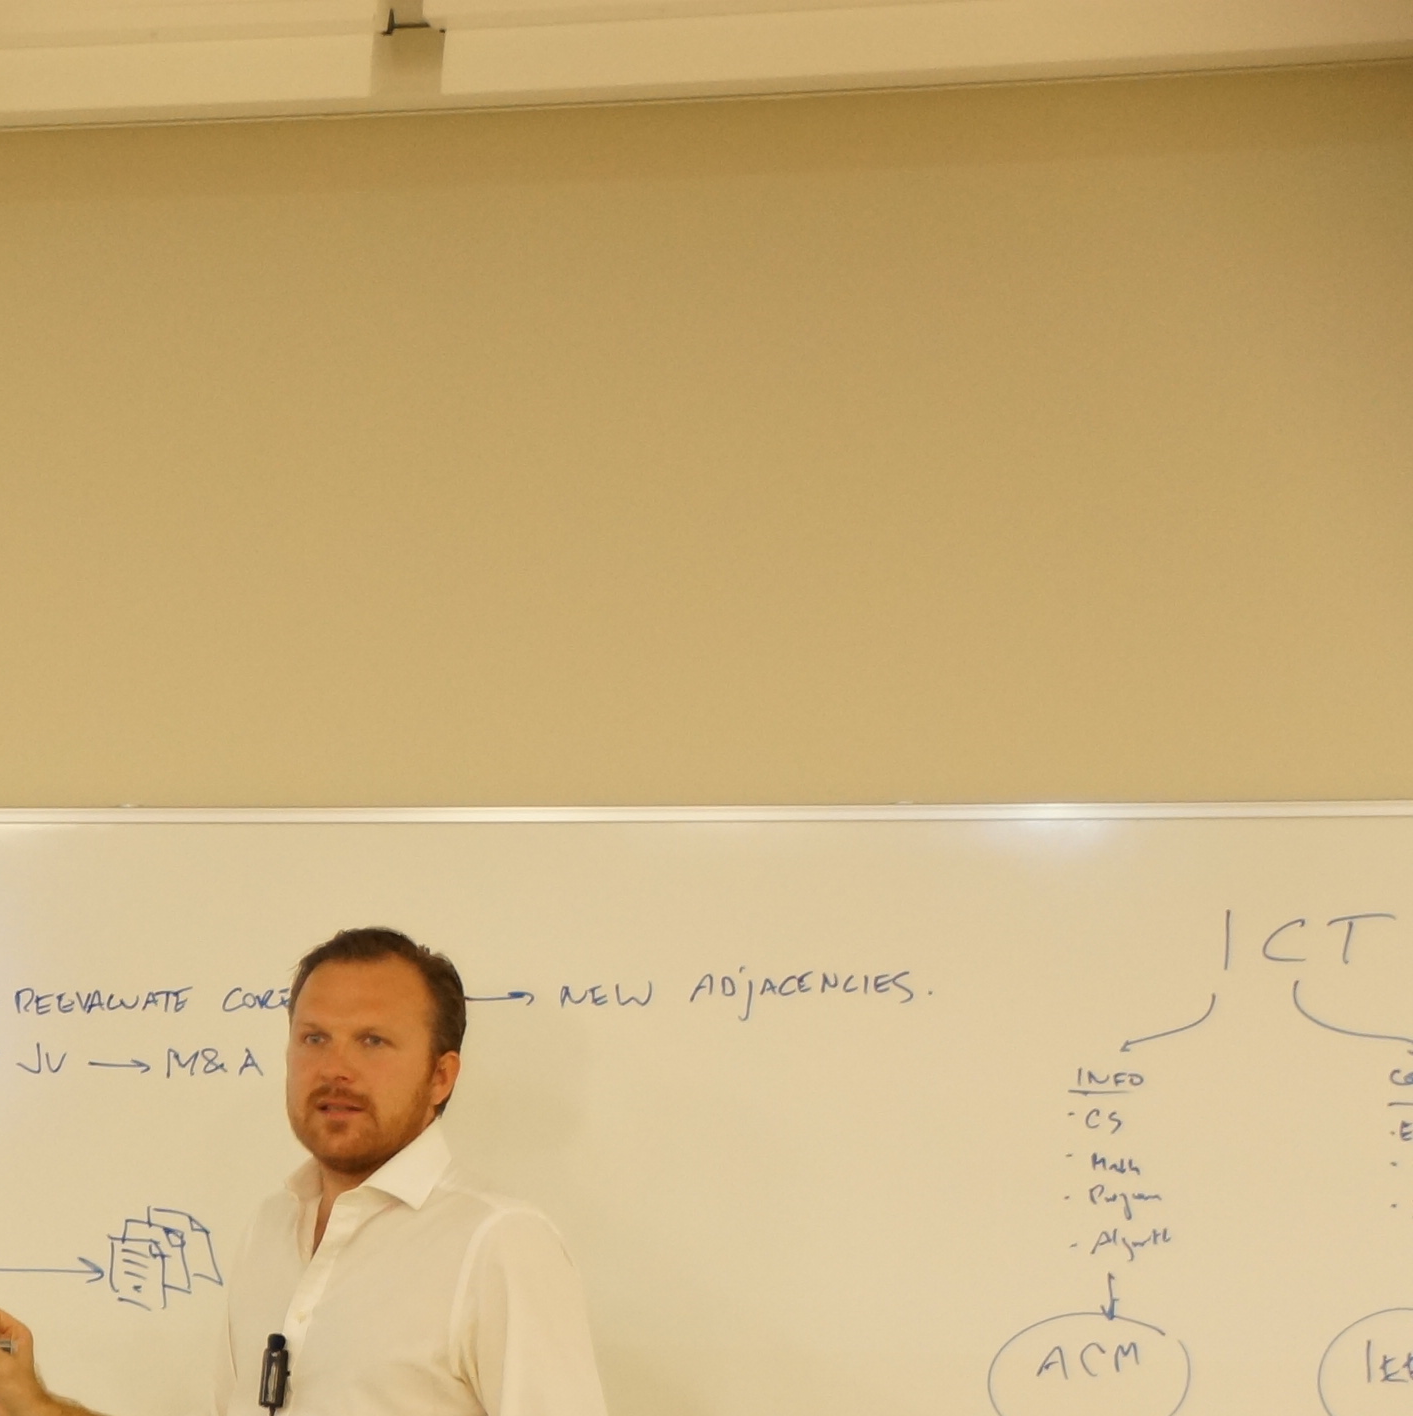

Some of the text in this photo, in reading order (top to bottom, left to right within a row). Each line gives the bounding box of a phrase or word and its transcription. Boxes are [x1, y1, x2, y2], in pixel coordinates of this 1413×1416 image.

[1223, 908, 1397, 971] ICT
[559, 980, 653, 1008] NEW
[16, 1042, 68, 1074] JV
[1076, 1067, 1145, 1087] INFO
[1084, 1107, 1123, 1135] CS
[1036, 1341, 1141, 1381] ACM
